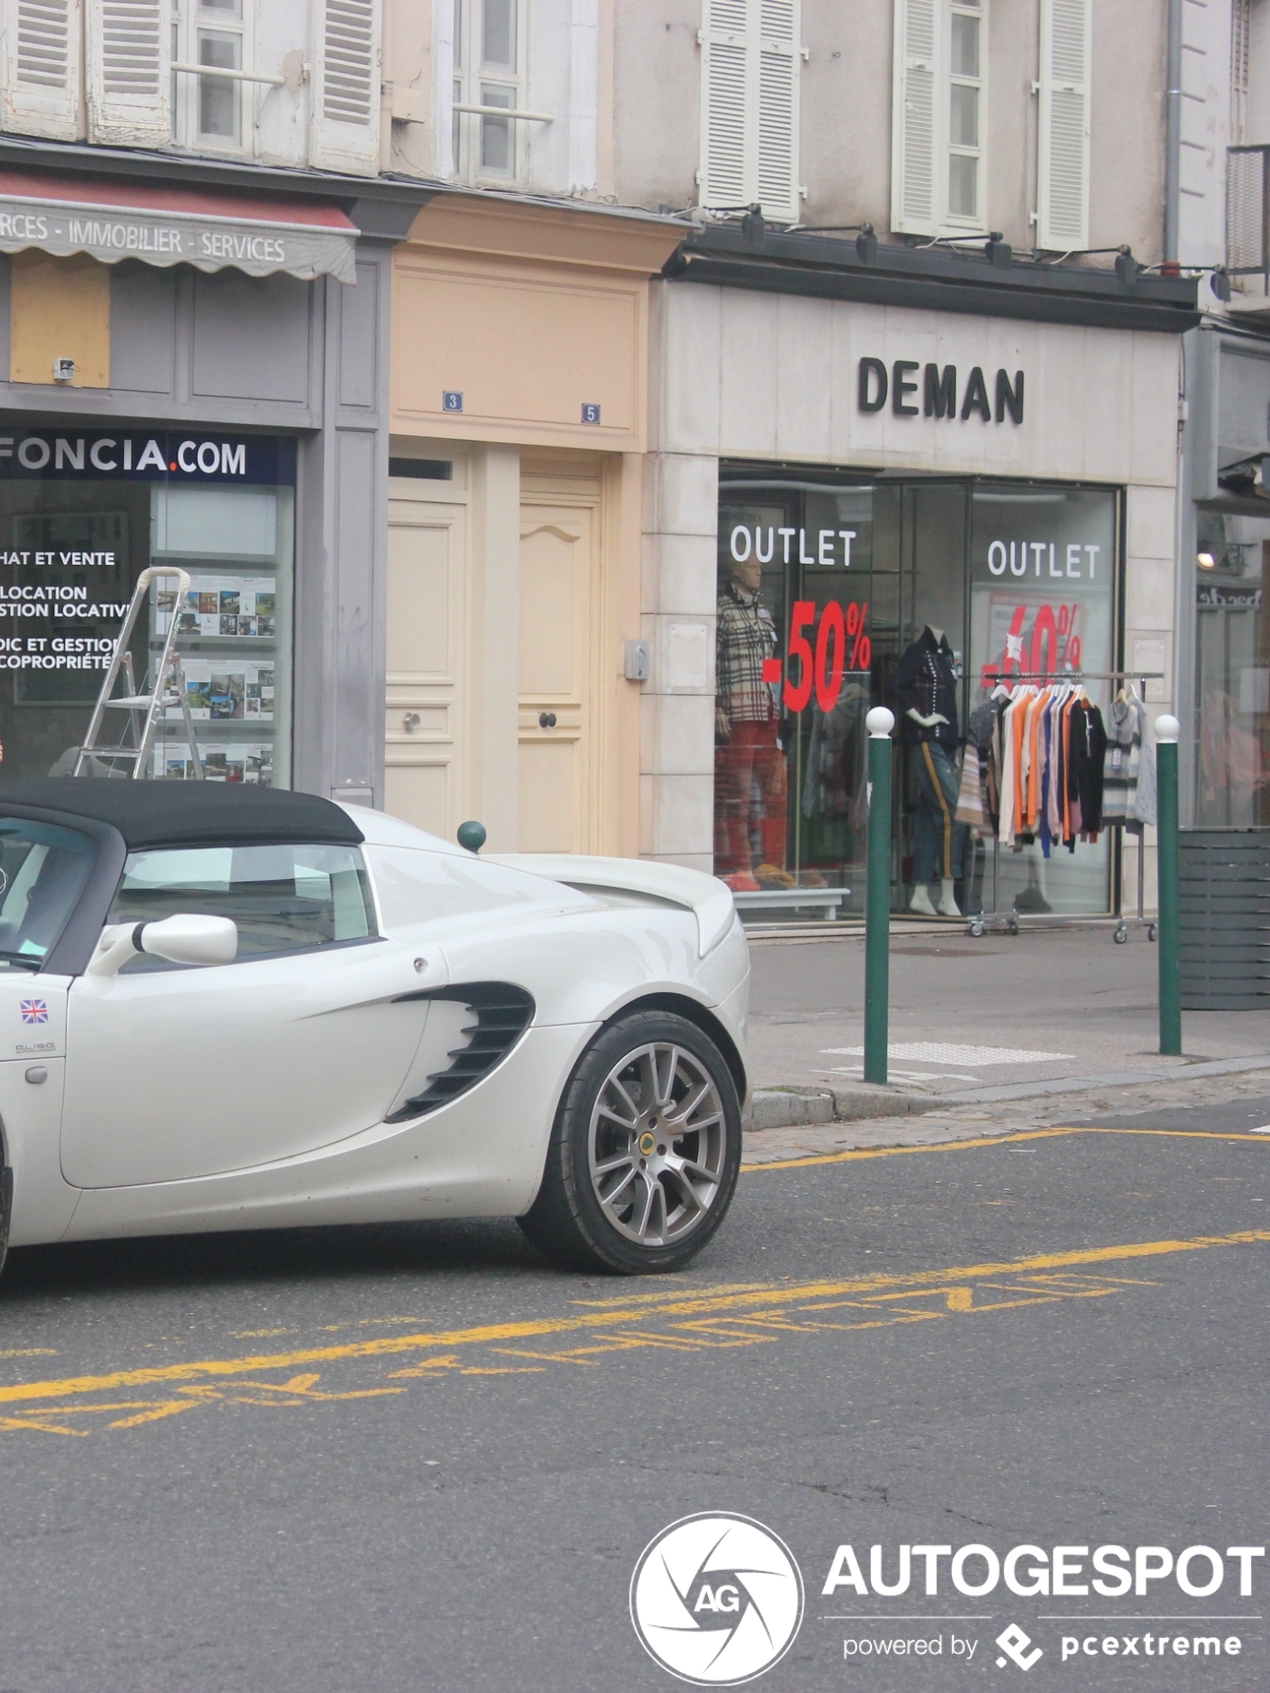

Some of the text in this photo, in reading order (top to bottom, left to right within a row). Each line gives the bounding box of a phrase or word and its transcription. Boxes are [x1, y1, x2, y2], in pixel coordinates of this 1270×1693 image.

[68, 219, 182, 253] IMMOBILIER
[201, 231, 285, 263] SERVICES
[858, 356, 1025, 425] DEMAN
[439, 394, 447, 408] 3
[587, 406, 595, 421] 5
[730, 525, 857, 567] OUTLET
[35, 552, 55, 565] ET
[59, 552, 115, 566] VENTE
[988, 540, 1100, 579] OUTLET
[0, 586, 87, 600] LOCATION
[53, 604, 130, 618] LOCATIV
[27, 638, 47, 651] ET
[761, 600, 872, 713] -50%
